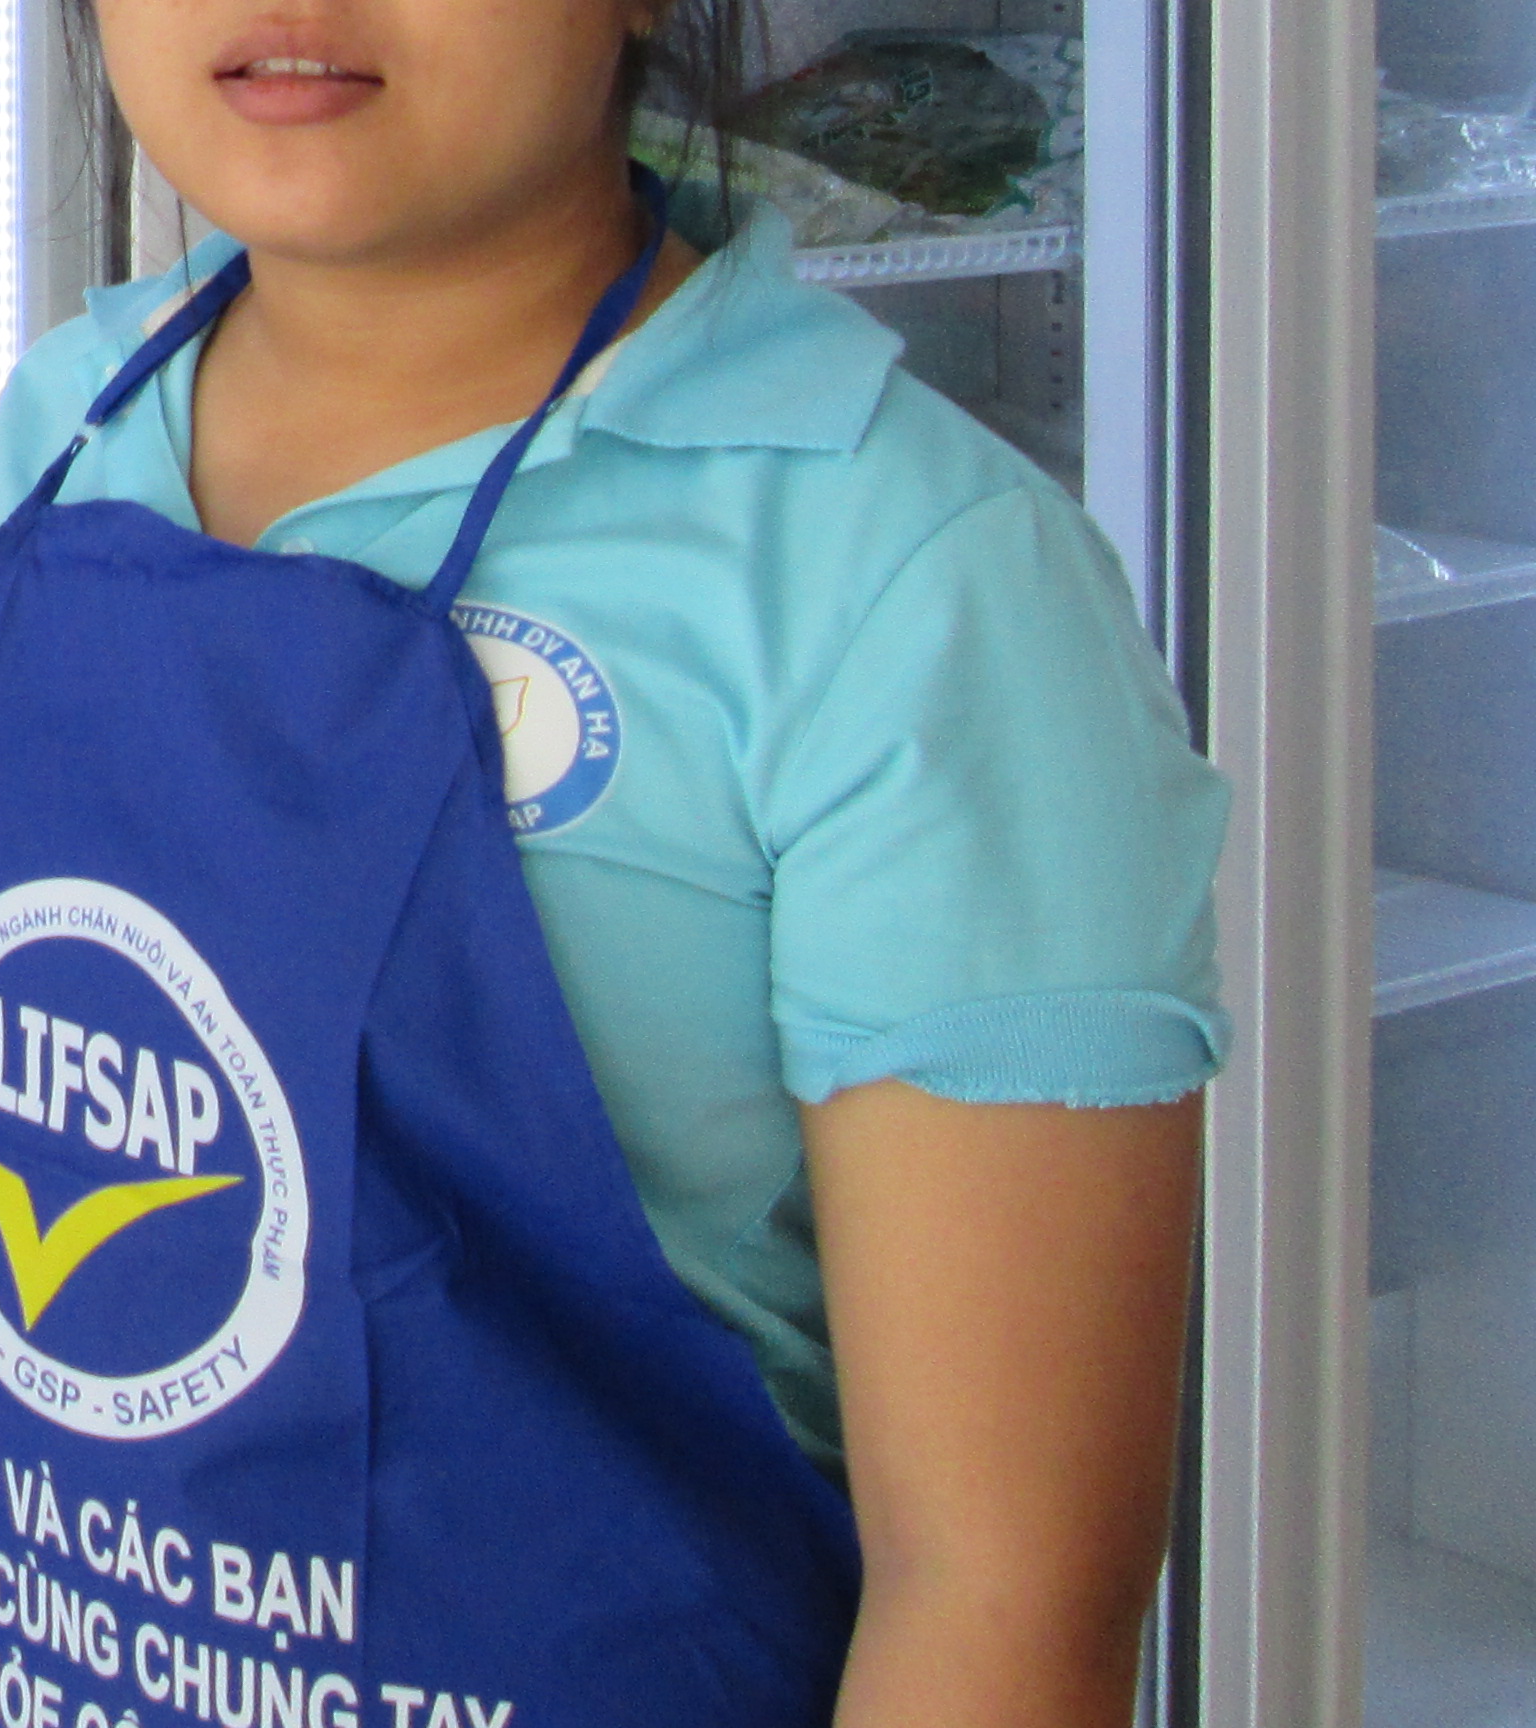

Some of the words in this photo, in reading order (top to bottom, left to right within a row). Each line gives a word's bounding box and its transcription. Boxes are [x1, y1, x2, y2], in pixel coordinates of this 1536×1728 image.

[521, 625, 564, 657] DV
[557, 656, 601, 700] AN
[0, 904, 62, 943] NGÀNH
[67, 905, 119, 937] CHĂN
[123, 924, 168, 971] NUÔI
[166, 960, 192, 1003] VÀ
[191, 998, 219, 1036] AN
[219, 1033, 267, 1111] TOÀN
[13, 1354, 82, 1412] GSP
[112, 1333, 250, 1426] SAFETY
[4, 1459, 71, 1558] VÀ
[79, 1497, 195, 1606] CÁC
[211, 1542, 355, 1652] BẠN
[134, 1622, 359, 1728] CHUNG
